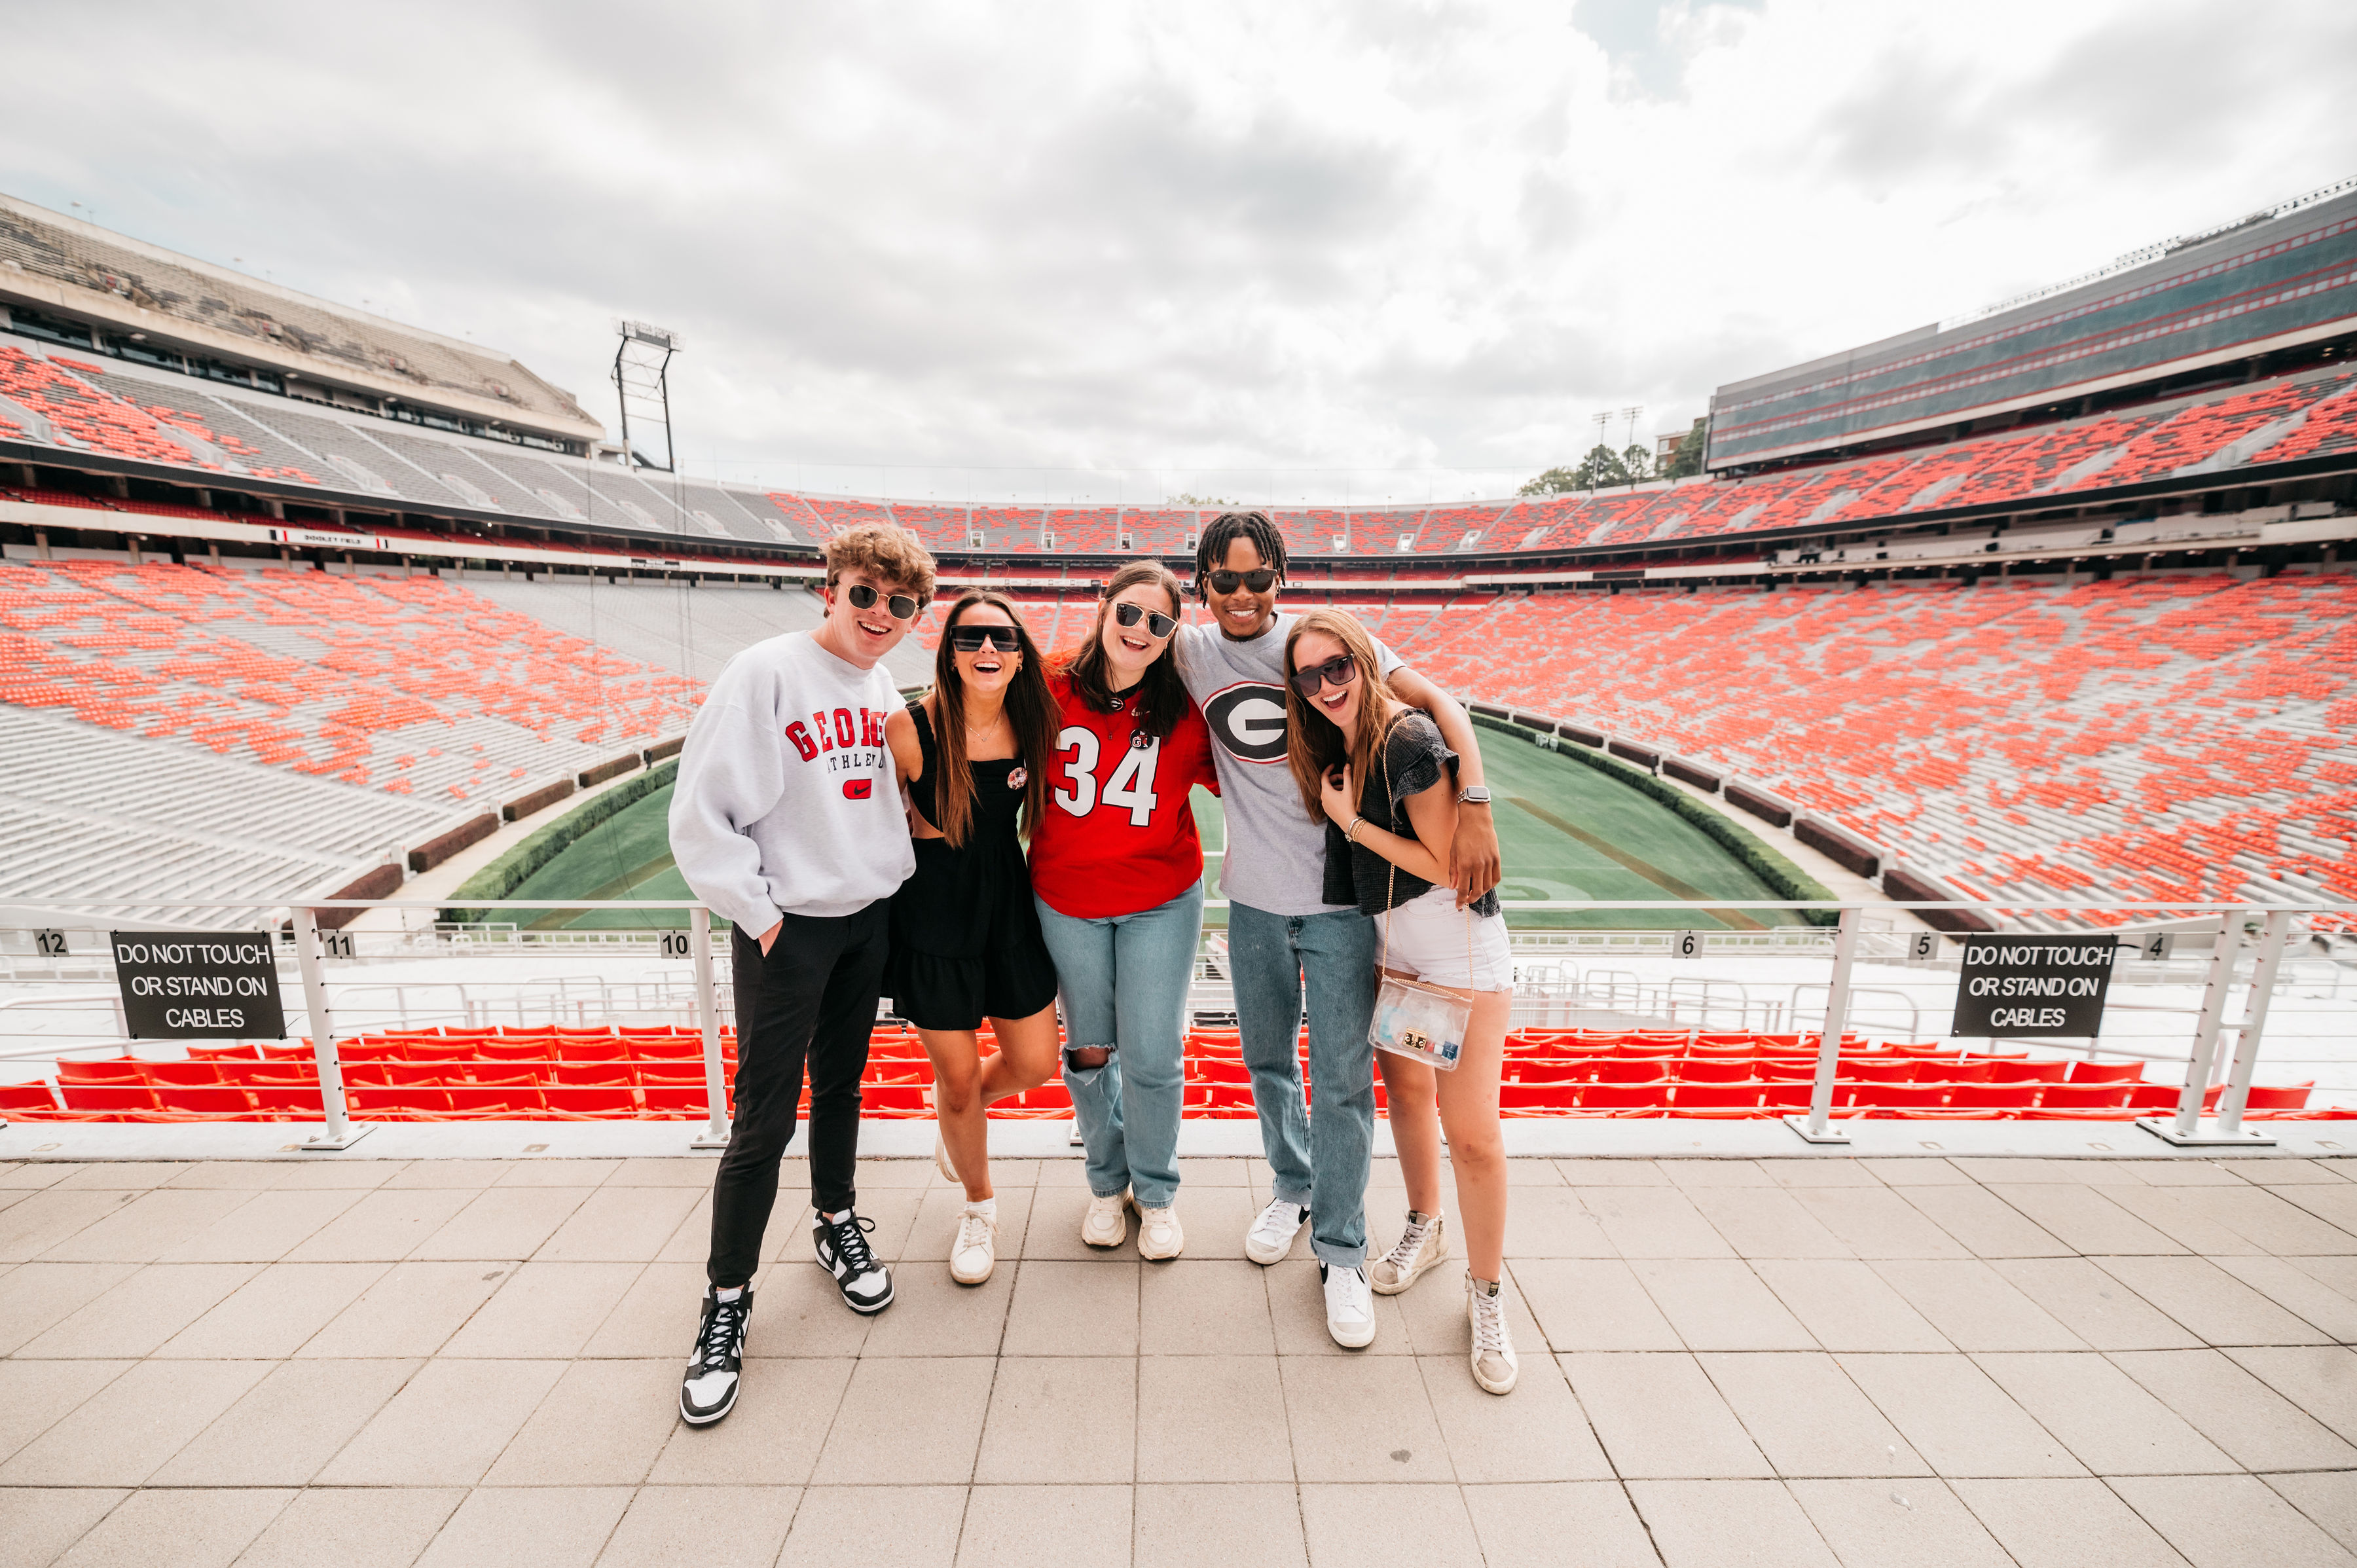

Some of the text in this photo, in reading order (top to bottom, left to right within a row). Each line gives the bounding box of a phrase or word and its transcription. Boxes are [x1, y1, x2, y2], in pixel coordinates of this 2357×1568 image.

[1202, 681, 1288, 764] G
[1132, 736, 1142, 747] G
[1055, 725, 1161, 828] 34
[38, 933, 66, 953] 12
[327, 936, 350, 955] 11
[663, 935, 688, 954] 10
[1682, 936, 1694, 955] 6
[1917, 936, 1931, 955] 5
[2149, 937, 2164, 956] 4
[117, 944, 270, 964] DO NOT TOUCH
[1966, 946, 2113, 966] DO NOT TOUCH
[132, 976, 268, 996] OR STAND ON
[1969, 977, 2100, 996] OR STAND ON
[166, 1008, 245, 1028] CABLES
[1990, 1008, 2066, 1027] CABLES
